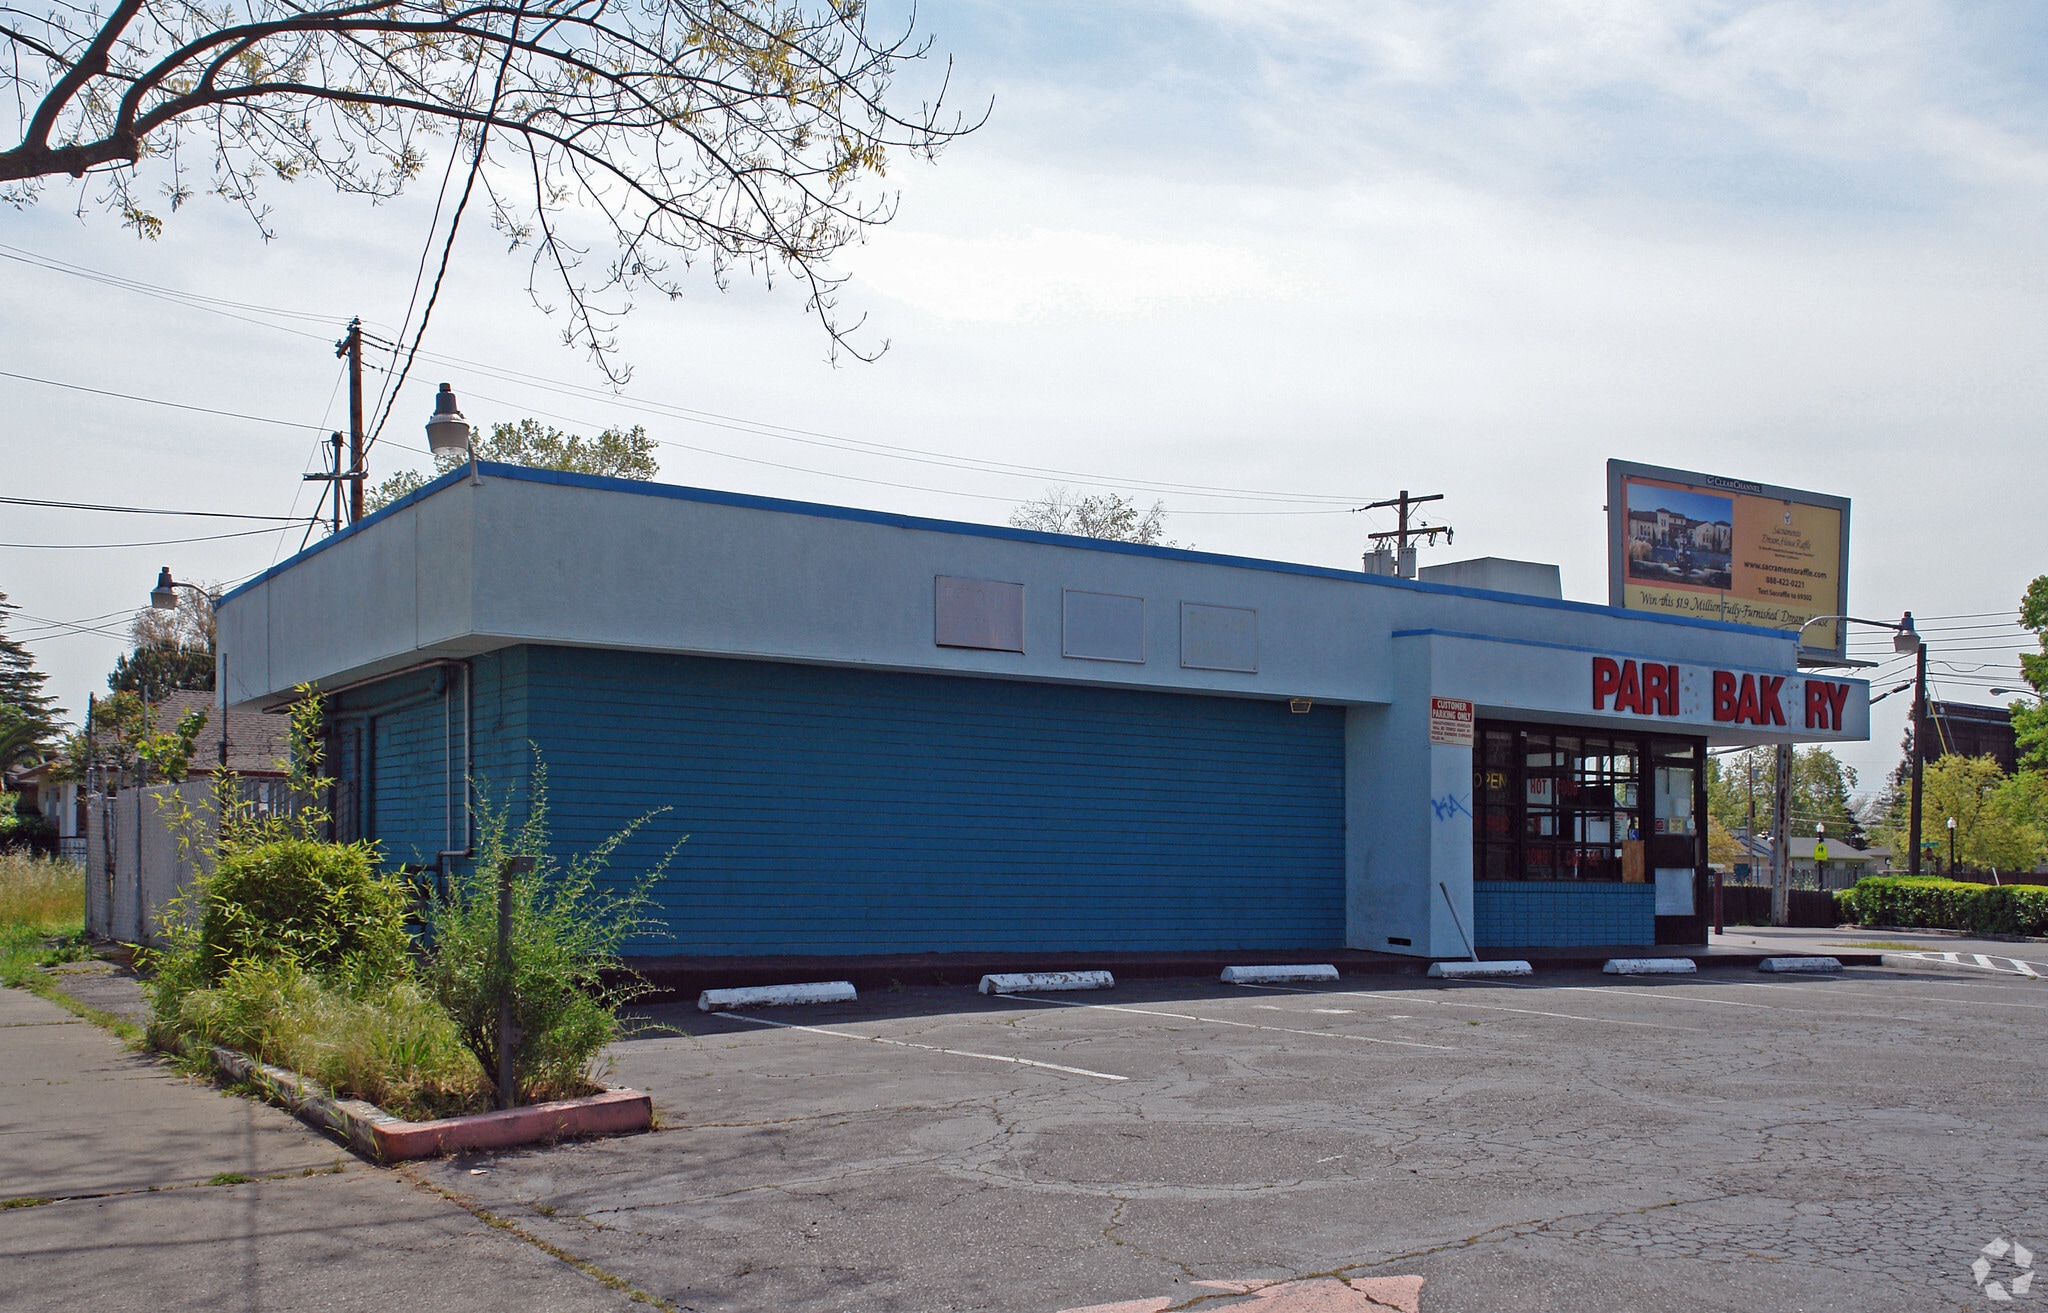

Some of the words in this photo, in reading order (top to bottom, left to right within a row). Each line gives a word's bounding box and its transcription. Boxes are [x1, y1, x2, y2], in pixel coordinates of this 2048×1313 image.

[1744, 561, 1827, 578] www.sacramentoraffle.com
[1766, 576, 1804, 588] 888-422-0221
[1640, 591, 1658, 605] Win
[1659, 592, 1674, 607] this
[1690, 597, 1721, 612] Million
[1781, 610, 1804, 623] Dream
[1438, 700, 1467, 711] CUSTOMER
[1432, 709, 1456, 720] PARKING
[1458, 712, 1471, 720] ONLY
[1530, 779, 1547, 794] HOT
